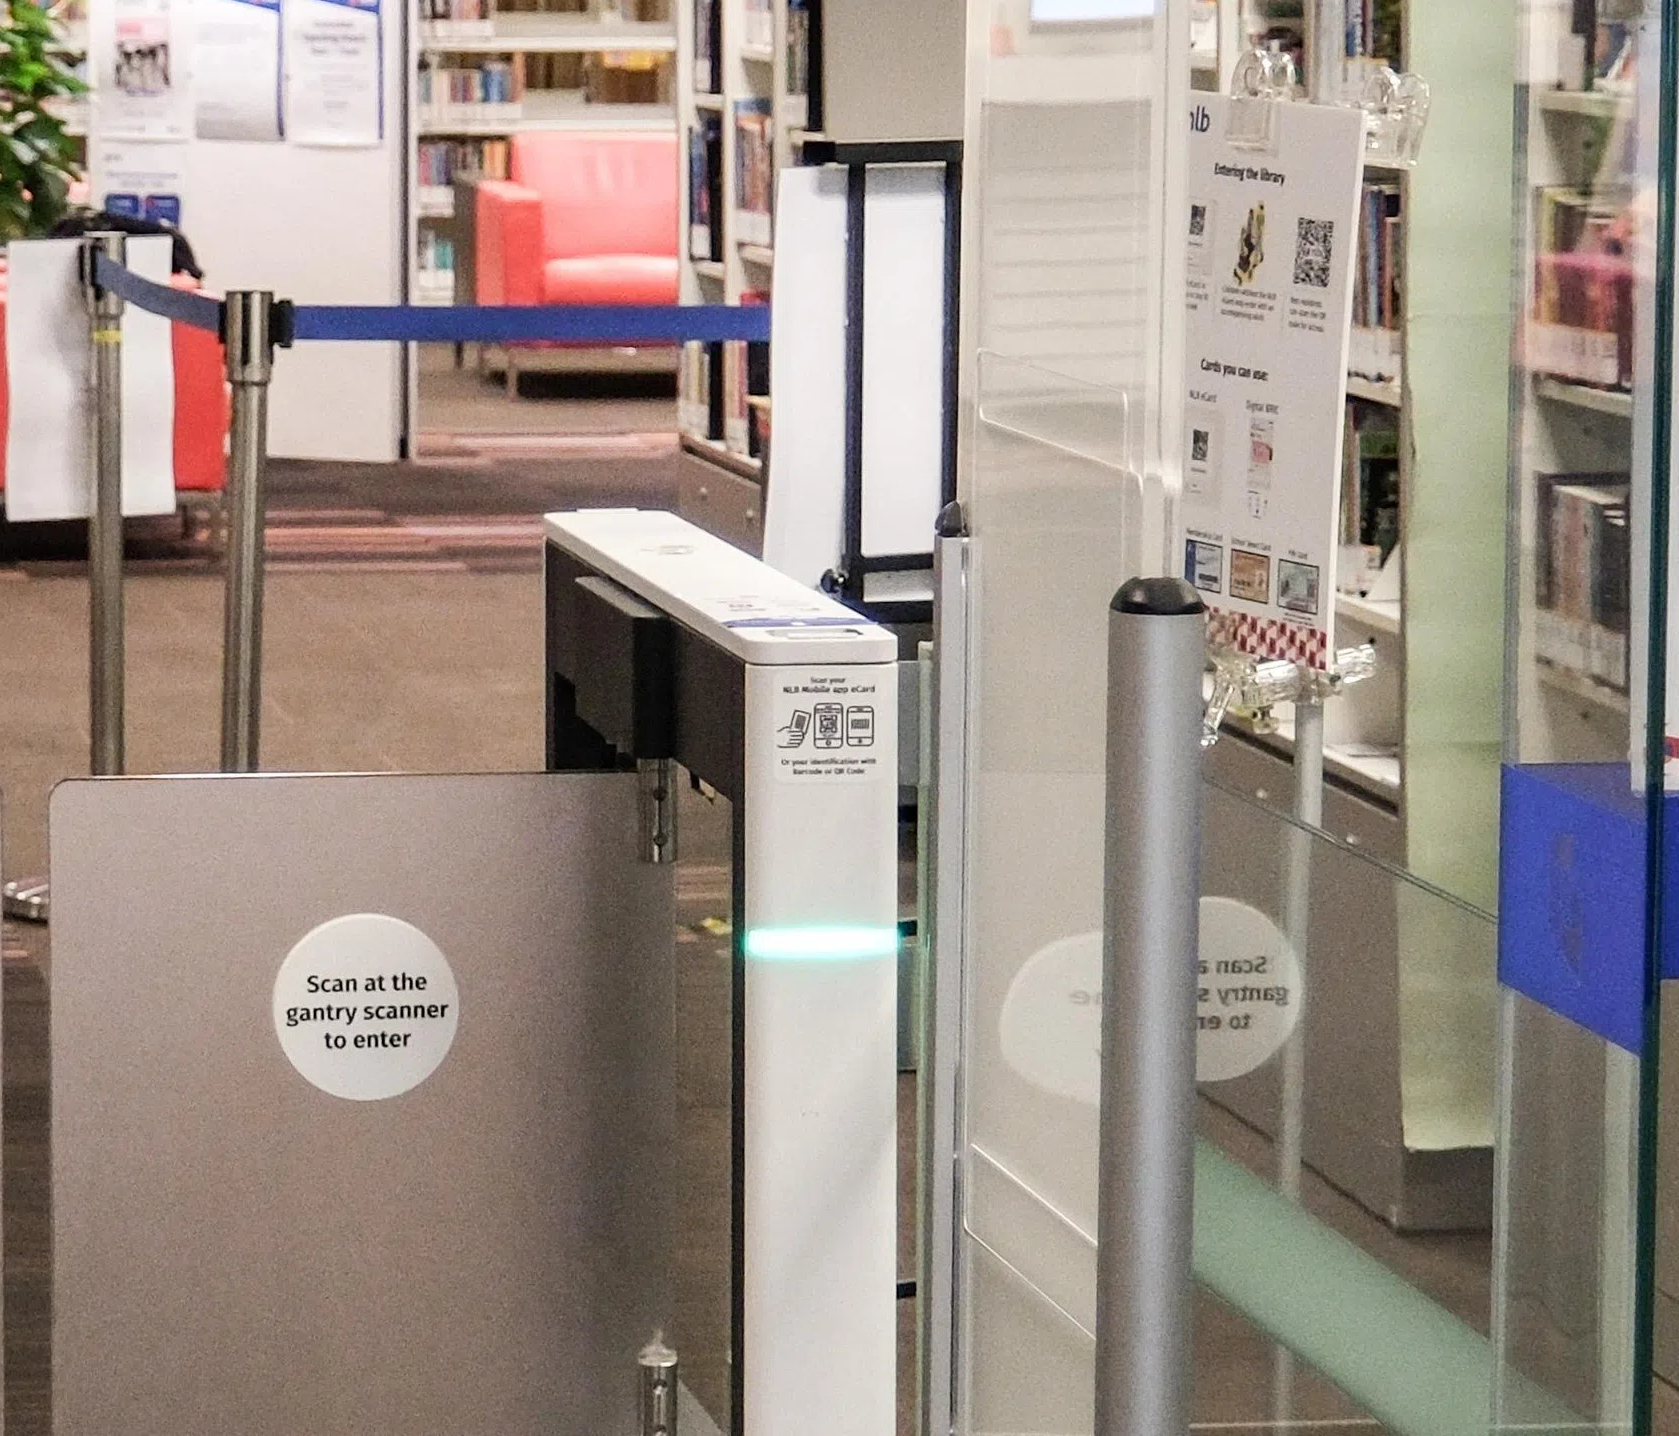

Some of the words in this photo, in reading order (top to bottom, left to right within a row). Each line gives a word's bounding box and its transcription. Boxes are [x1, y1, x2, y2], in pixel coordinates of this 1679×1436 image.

[850, 685, 876, 693] eCard
[306, 975, 358, 994] Scan
[364, 975, 386, 992] at
[391, 972, 428, 992] the
[286, 1004, 358, 1027] gantry
[363, 1004, 449, 1021] scanner
[324, 1032, 347, 1050] to
[353, 1031, 412, 1049] enter
